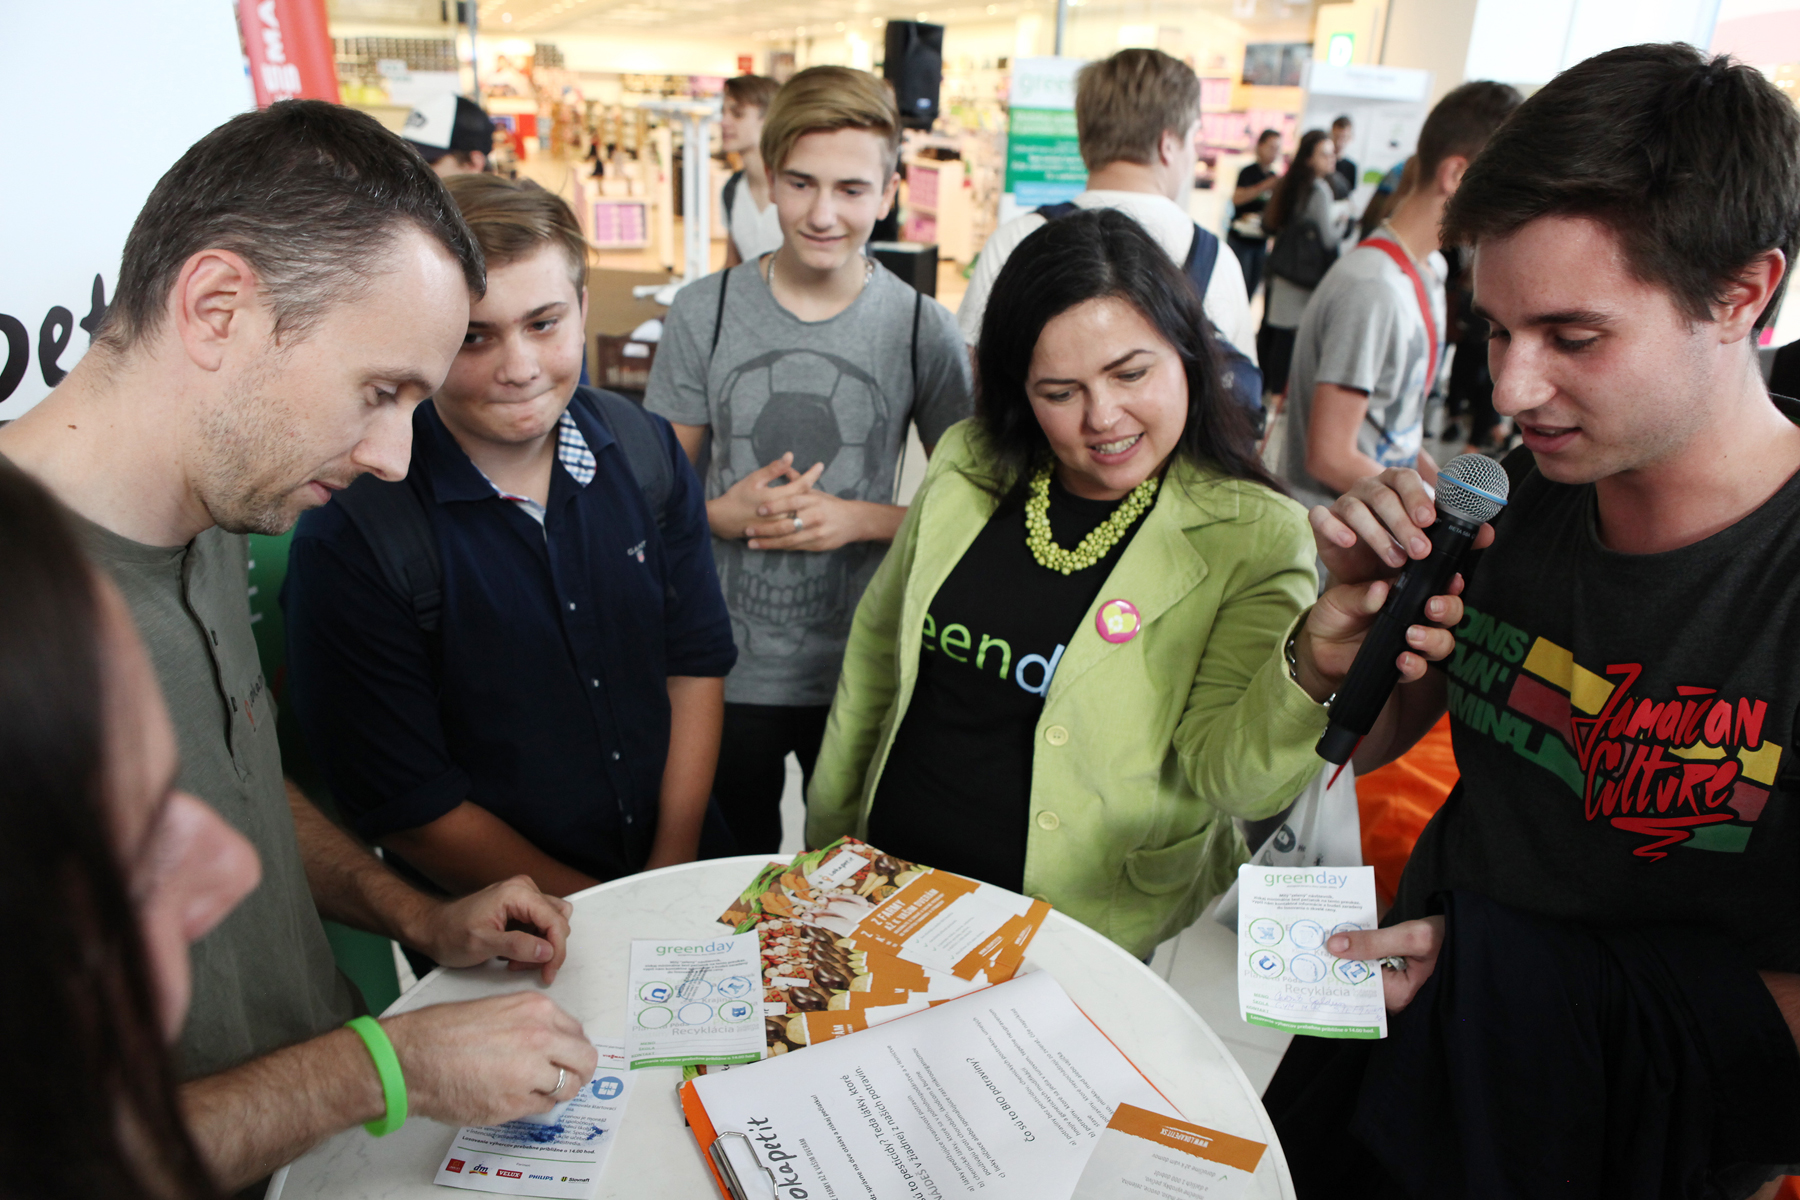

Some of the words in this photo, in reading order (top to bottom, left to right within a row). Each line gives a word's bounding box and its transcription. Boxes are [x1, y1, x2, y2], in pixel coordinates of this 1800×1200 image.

[1264, 871, 1347, 888] greenday
[876, 899, 906, 921] FARMY
[871, 917, 883, 926] Z
[656, 941, 735, 956] greenday
[1285, 984, 1350, 997] Recyklácia
[672, 1025, 735, 1036] Recyklácia
[855, 1066, 881, 1100] potravín.
[966, 1057, 1002, 1096] potraviny?
[840, 1074, 859, 1096] ktoré
[810, 1094, 829, 1117] pečiatku!
[856, 1095, 872, 1118] látky,
[995, 1096, 1011, 1111] BIO
[874, 1100, 895, 1126] našich
[1008, 1110, 1018, 1120] to
[824, 1116, 836, 1131] získaj
[868, 1117, 884, 1139] Teda
[1014, 1120, 1027, 1130] sú
[1024, 1130, 1036, 1142] Čo
[1159, 1127, 1209, 1148] WWW.LOKAPETIT.SK
[798, 1138, 813, 1156] DVERÁM
[836, 1135, 849, 1153] otázky
[893, 1131, 918, 1162] žiadnej
[808, 1156, 821, 1171] VAŠIM
[846, 1153, 855, 1164] dve
[879, 1139, 914, 1180] pesticídy?
[473, 1164, 489, 1173] dm
[499, 1170, 521, 1178] VELUX
[852, 1163, 860, 1171] na
[818, 1174, 827, 1182] AŽ
[856, 1171, 872, 1194] správne
[822, 1182, 836, 1198] FARMY
[908, 1180, 918, 1192] to
